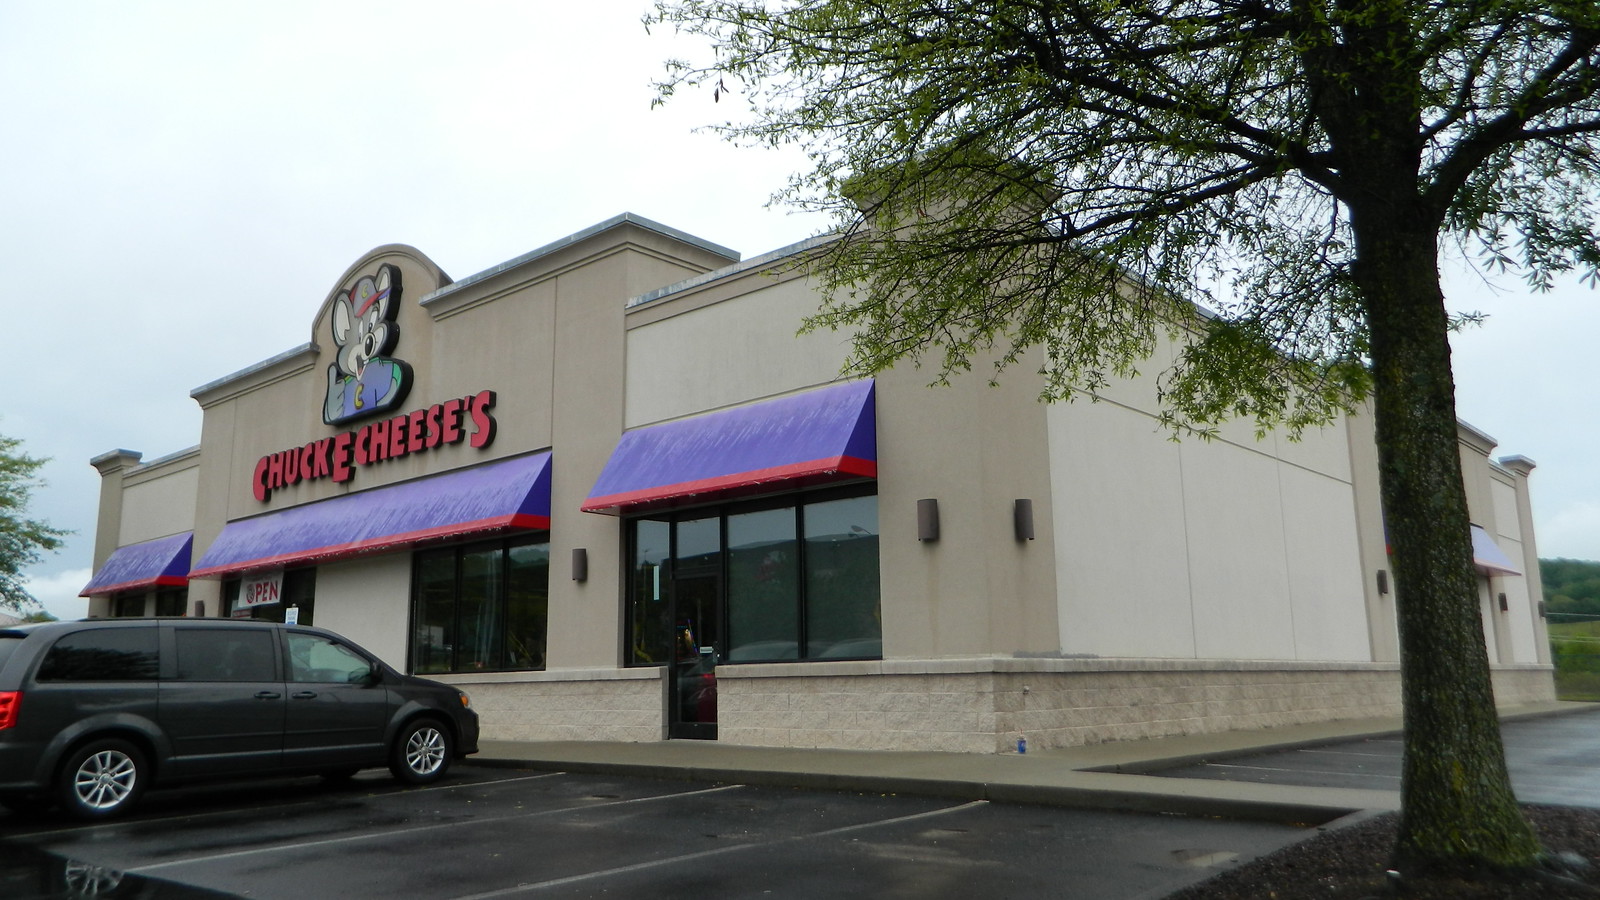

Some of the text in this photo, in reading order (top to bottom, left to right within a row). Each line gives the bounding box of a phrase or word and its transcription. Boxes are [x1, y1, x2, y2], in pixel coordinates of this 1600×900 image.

[354, 383, 364, 410] C
[253, 389, 497, 502] CHUCK E CHEESE'S
[246, 581, 279, 604] OPEN
